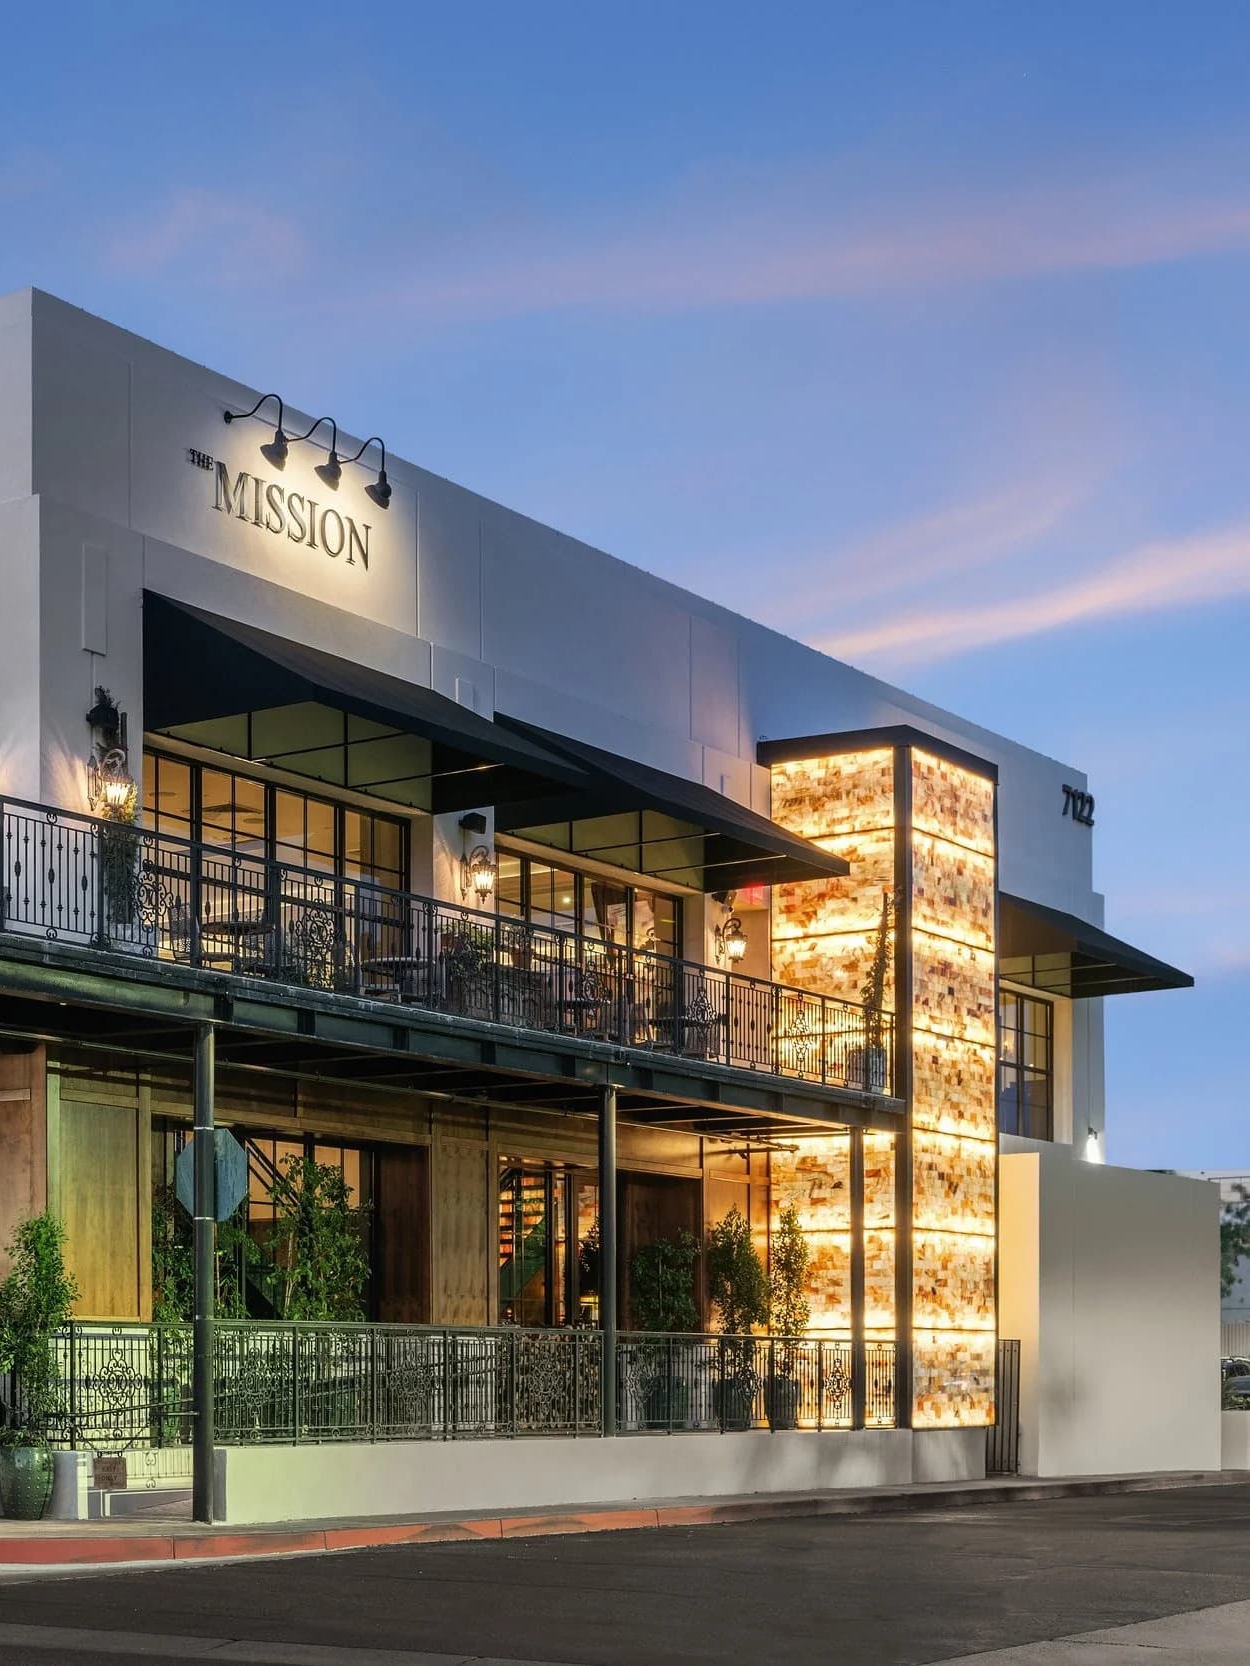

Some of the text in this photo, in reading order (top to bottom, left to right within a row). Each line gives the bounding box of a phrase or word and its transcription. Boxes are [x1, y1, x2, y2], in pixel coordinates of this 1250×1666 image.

[189, 448, 372, 572] THE MISSION
[1062, 784, 1095, 826] 7122
